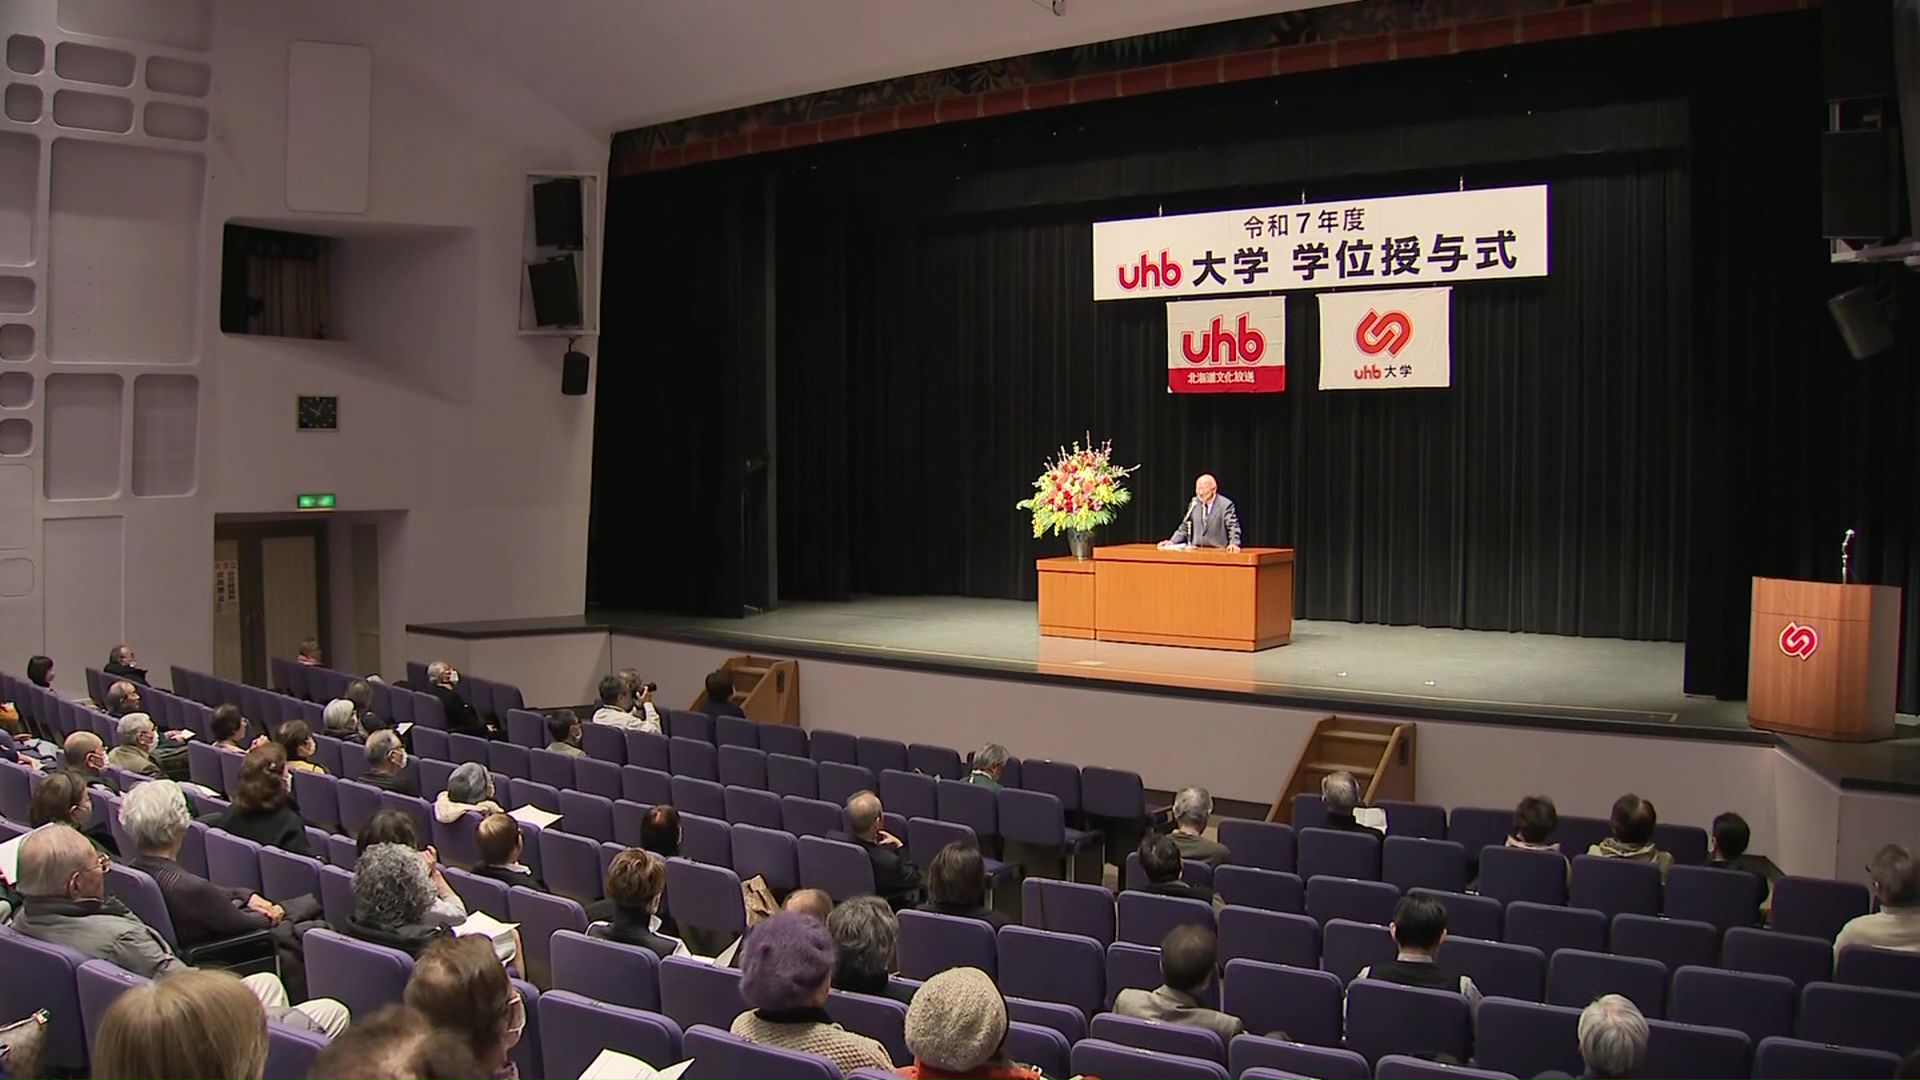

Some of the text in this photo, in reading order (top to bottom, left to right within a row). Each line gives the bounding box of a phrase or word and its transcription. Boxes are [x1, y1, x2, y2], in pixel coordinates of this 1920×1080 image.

[1243, 207, 1365, 239] 令和7年度
[1292, 230, 1517, 281] 学位授与式
[1182, 315, 1265, 365] uhb
